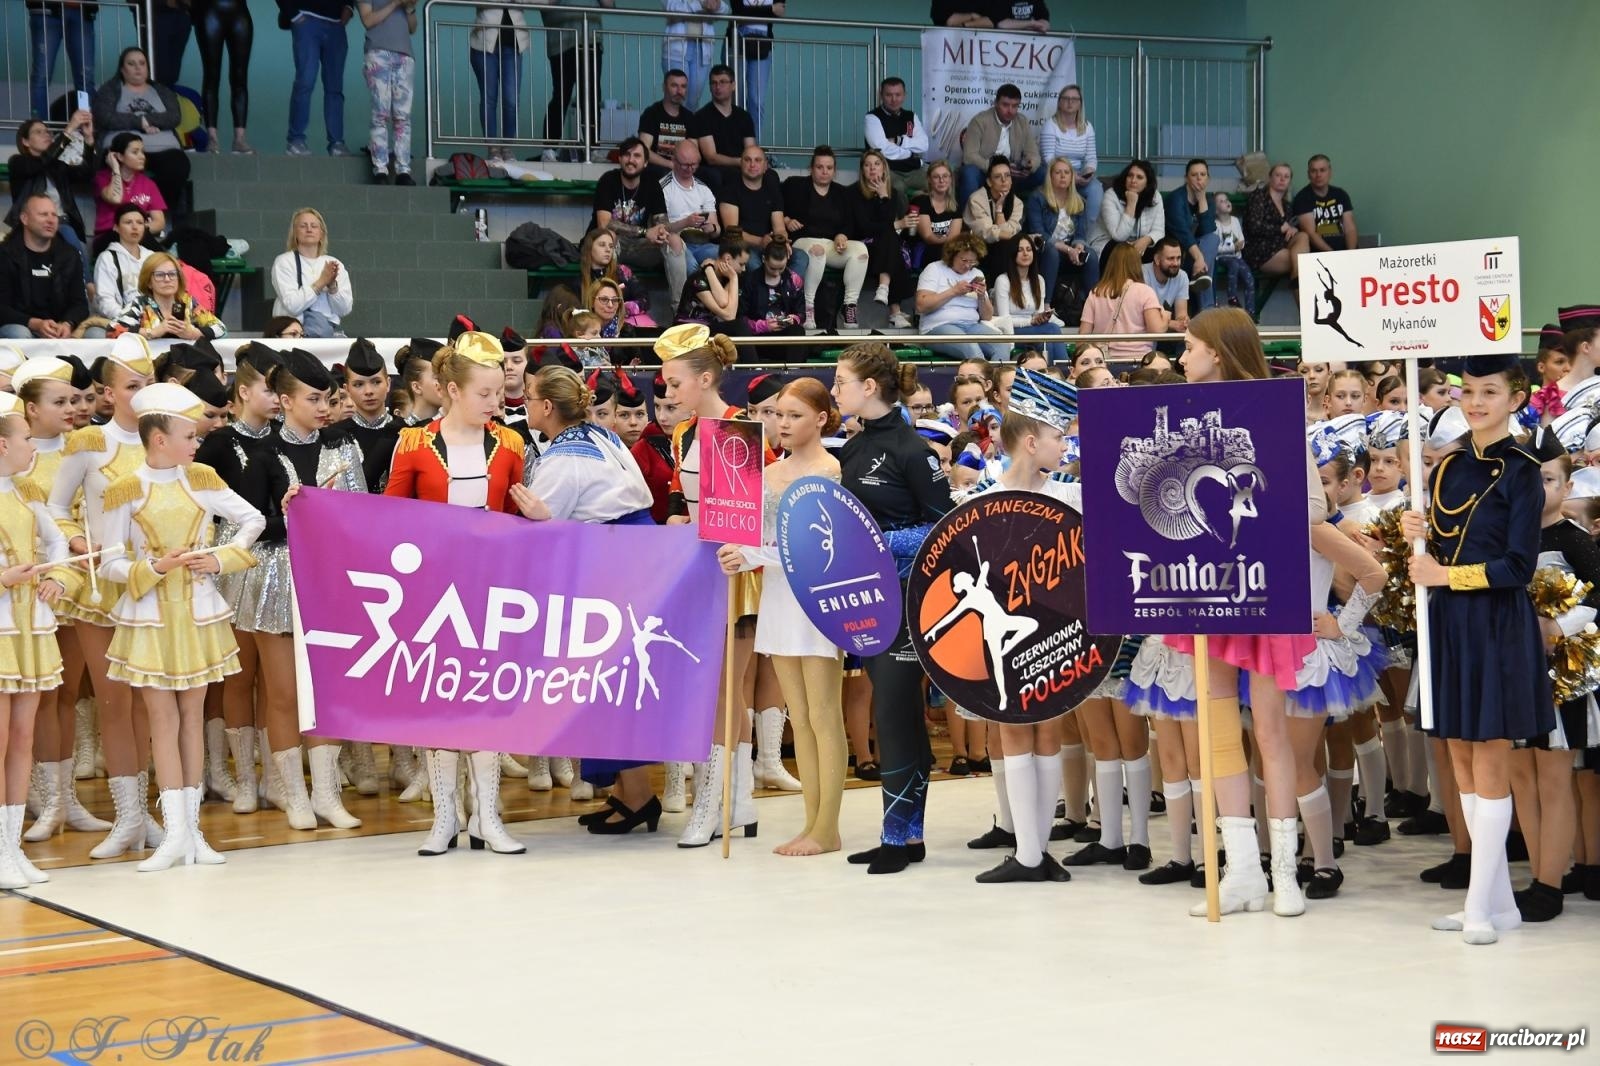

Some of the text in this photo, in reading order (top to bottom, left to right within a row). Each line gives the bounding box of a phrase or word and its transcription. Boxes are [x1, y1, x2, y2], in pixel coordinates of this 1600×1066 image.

[944, 84, 982, 97] Operator
[944, 95, 989, 105] Pracownik
[1379, 253, 1437, 270] Mażoretki
[1360, 273, 1460, 308] Presto
[1382, 315, 1437, 334] Mykanów
[735, 500, 758, 510] SCHOOL
[704, 510, 757, 532] IZBICKO
[781, 483, 886, 573] RYBNICKA AKADEMIA MAŻORETEK
[921, 500, 1064, 577] FORMACJA TANECZNA
[1122, 550, 1267, 604] Fantazja
[818, 587, 885, 614] ENIGMA
[1187, 604, 1267, 617] MAŻORETEK
[843, 616, 878, 632] POLAND
[1011, 619, 1083, 670] CZERWIONKA
[1019, 634, 1083, 681] -LESZCZYNY
[384, 639, 632, 707] Mażoretki
[1019, 643, 1103, 711] POLSKA
